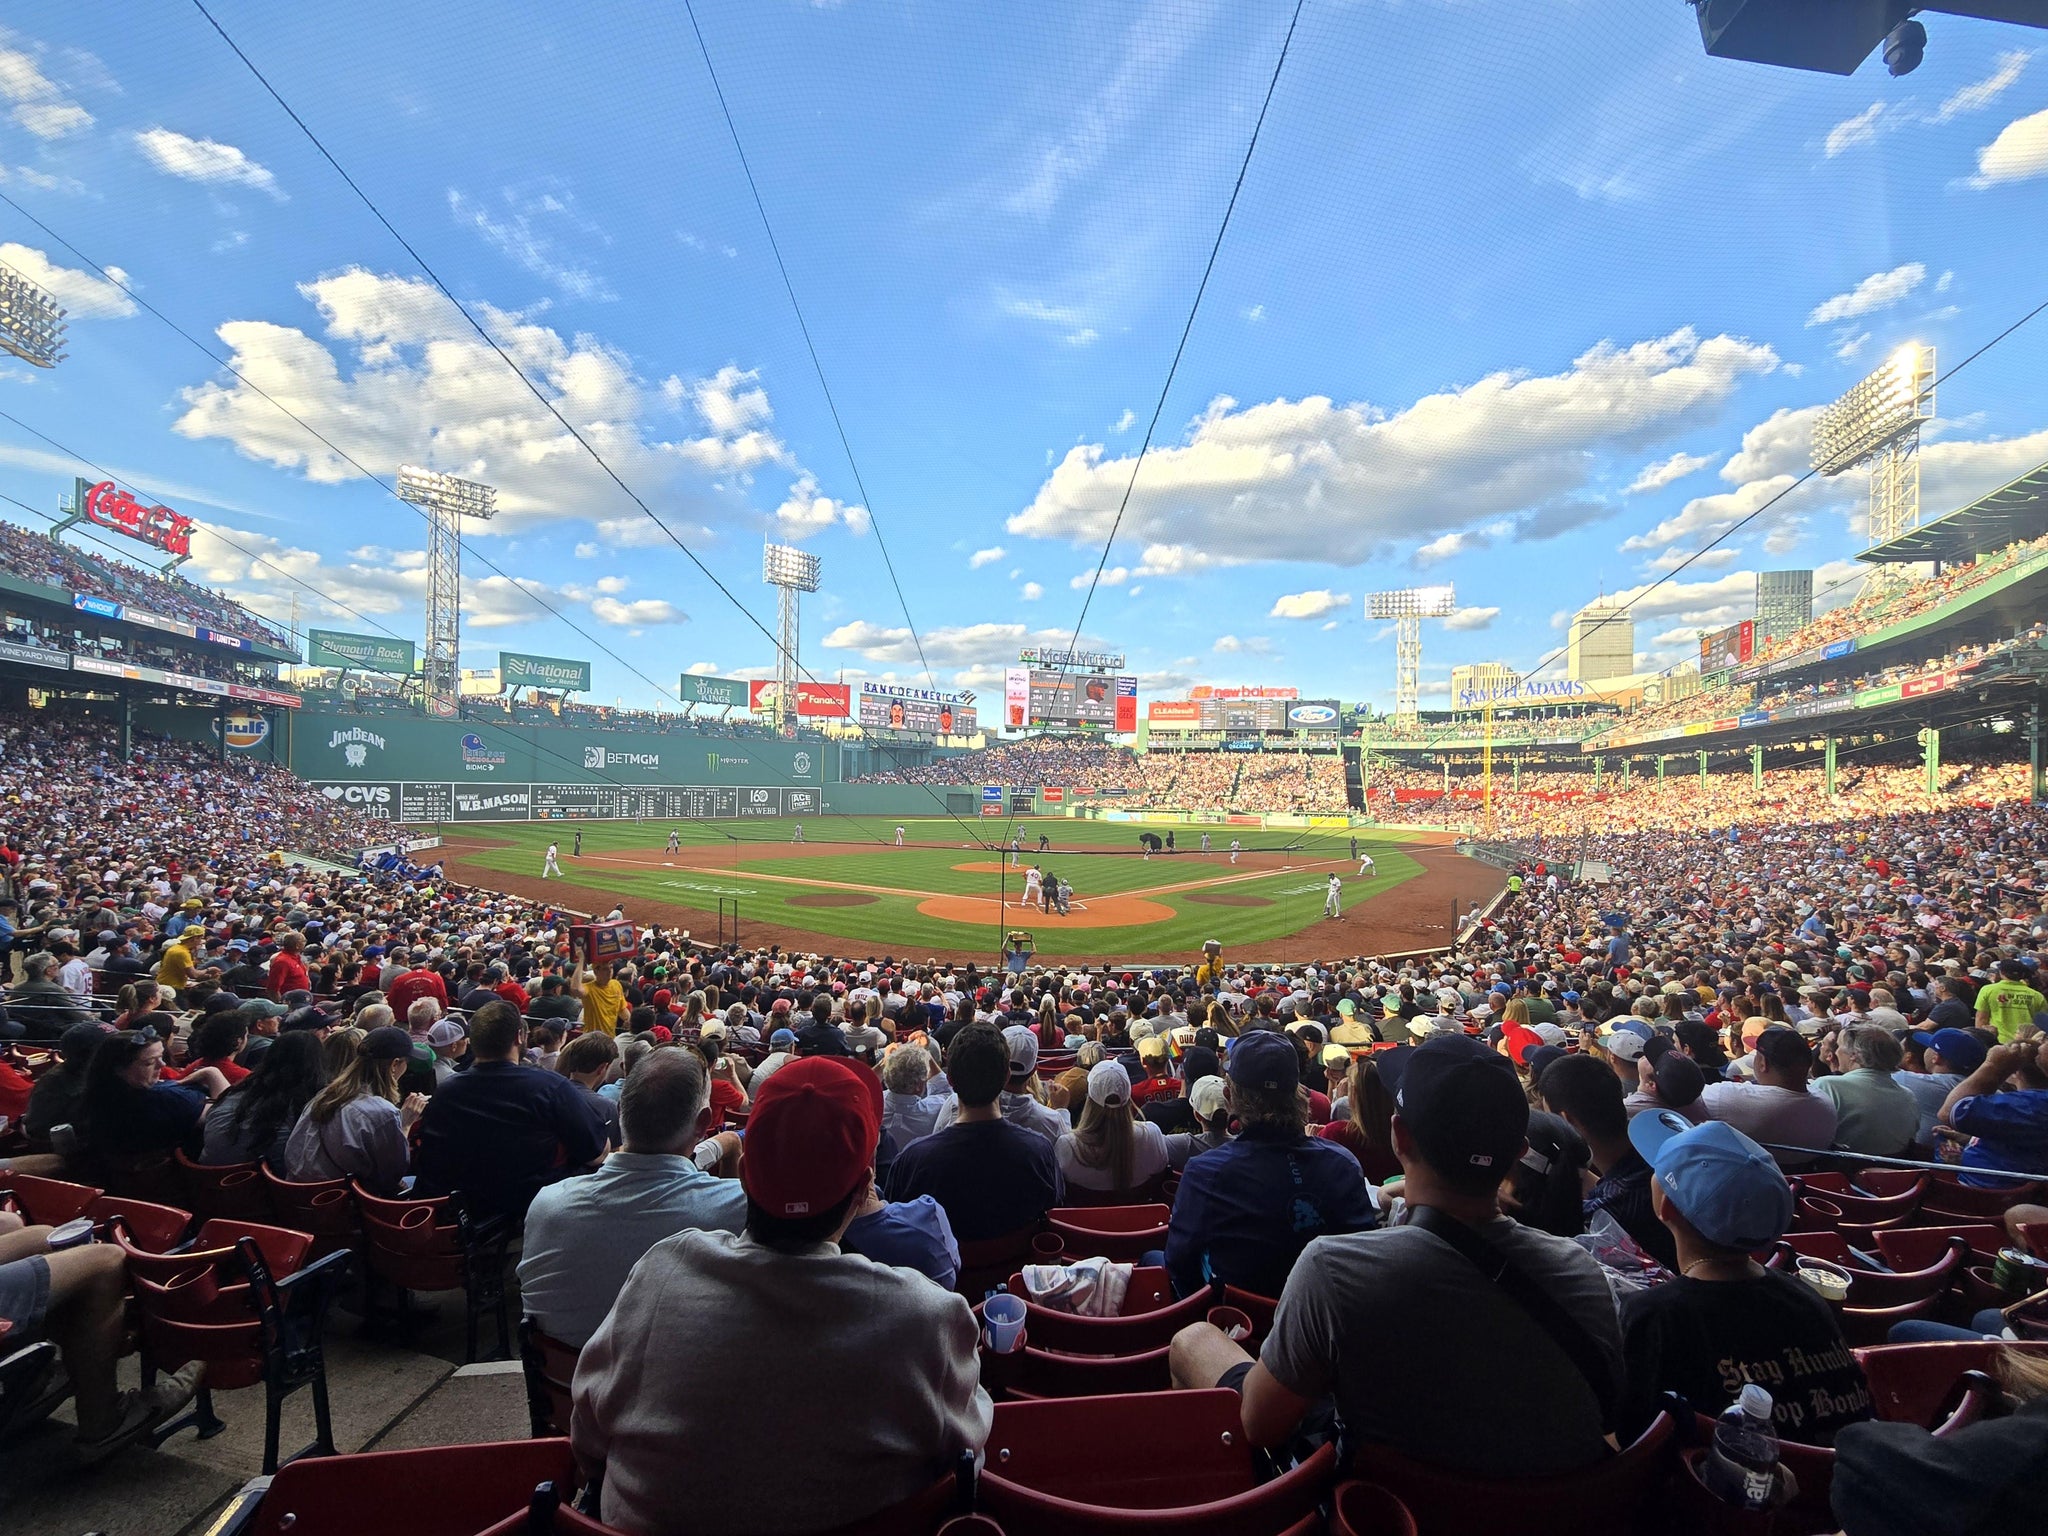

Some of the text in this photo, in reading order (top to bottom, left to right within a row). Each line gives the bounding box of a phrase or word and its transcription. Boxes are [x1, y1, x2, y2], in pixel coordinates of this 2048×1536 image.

[1, 646, 67, 665] VINEYARD VINES
[320, 640, 405, 659] Plymouth Rock
[1040, 648, 1124, 669] MassMutual
[525, 661, 583, 681] National
[559, 678, 580, 687] Rental
[1524, 680, 1584, 697] ADAMS
[698, 685, 732, 696] DRAFT
[864, 681, 896, 696] BANK
[913, 689, 958, 703] AMERICA
[1214, 685, 1297, 699] new balance
[701, 693, 731, 703] KINGS
[808, 694, 845, 705] Fanatics
[1298, 708, 1328, 722] Ford
[607, 752, 660, 766] BETMGM
[720, 757, 749, 765] MONSTER
[344, 786, 391, 803] CVS
[792, 794, 811, 802] ACE
[755, 807, 777, 815] WEBB
[1716, 1355, 1785, 1394] Stay
